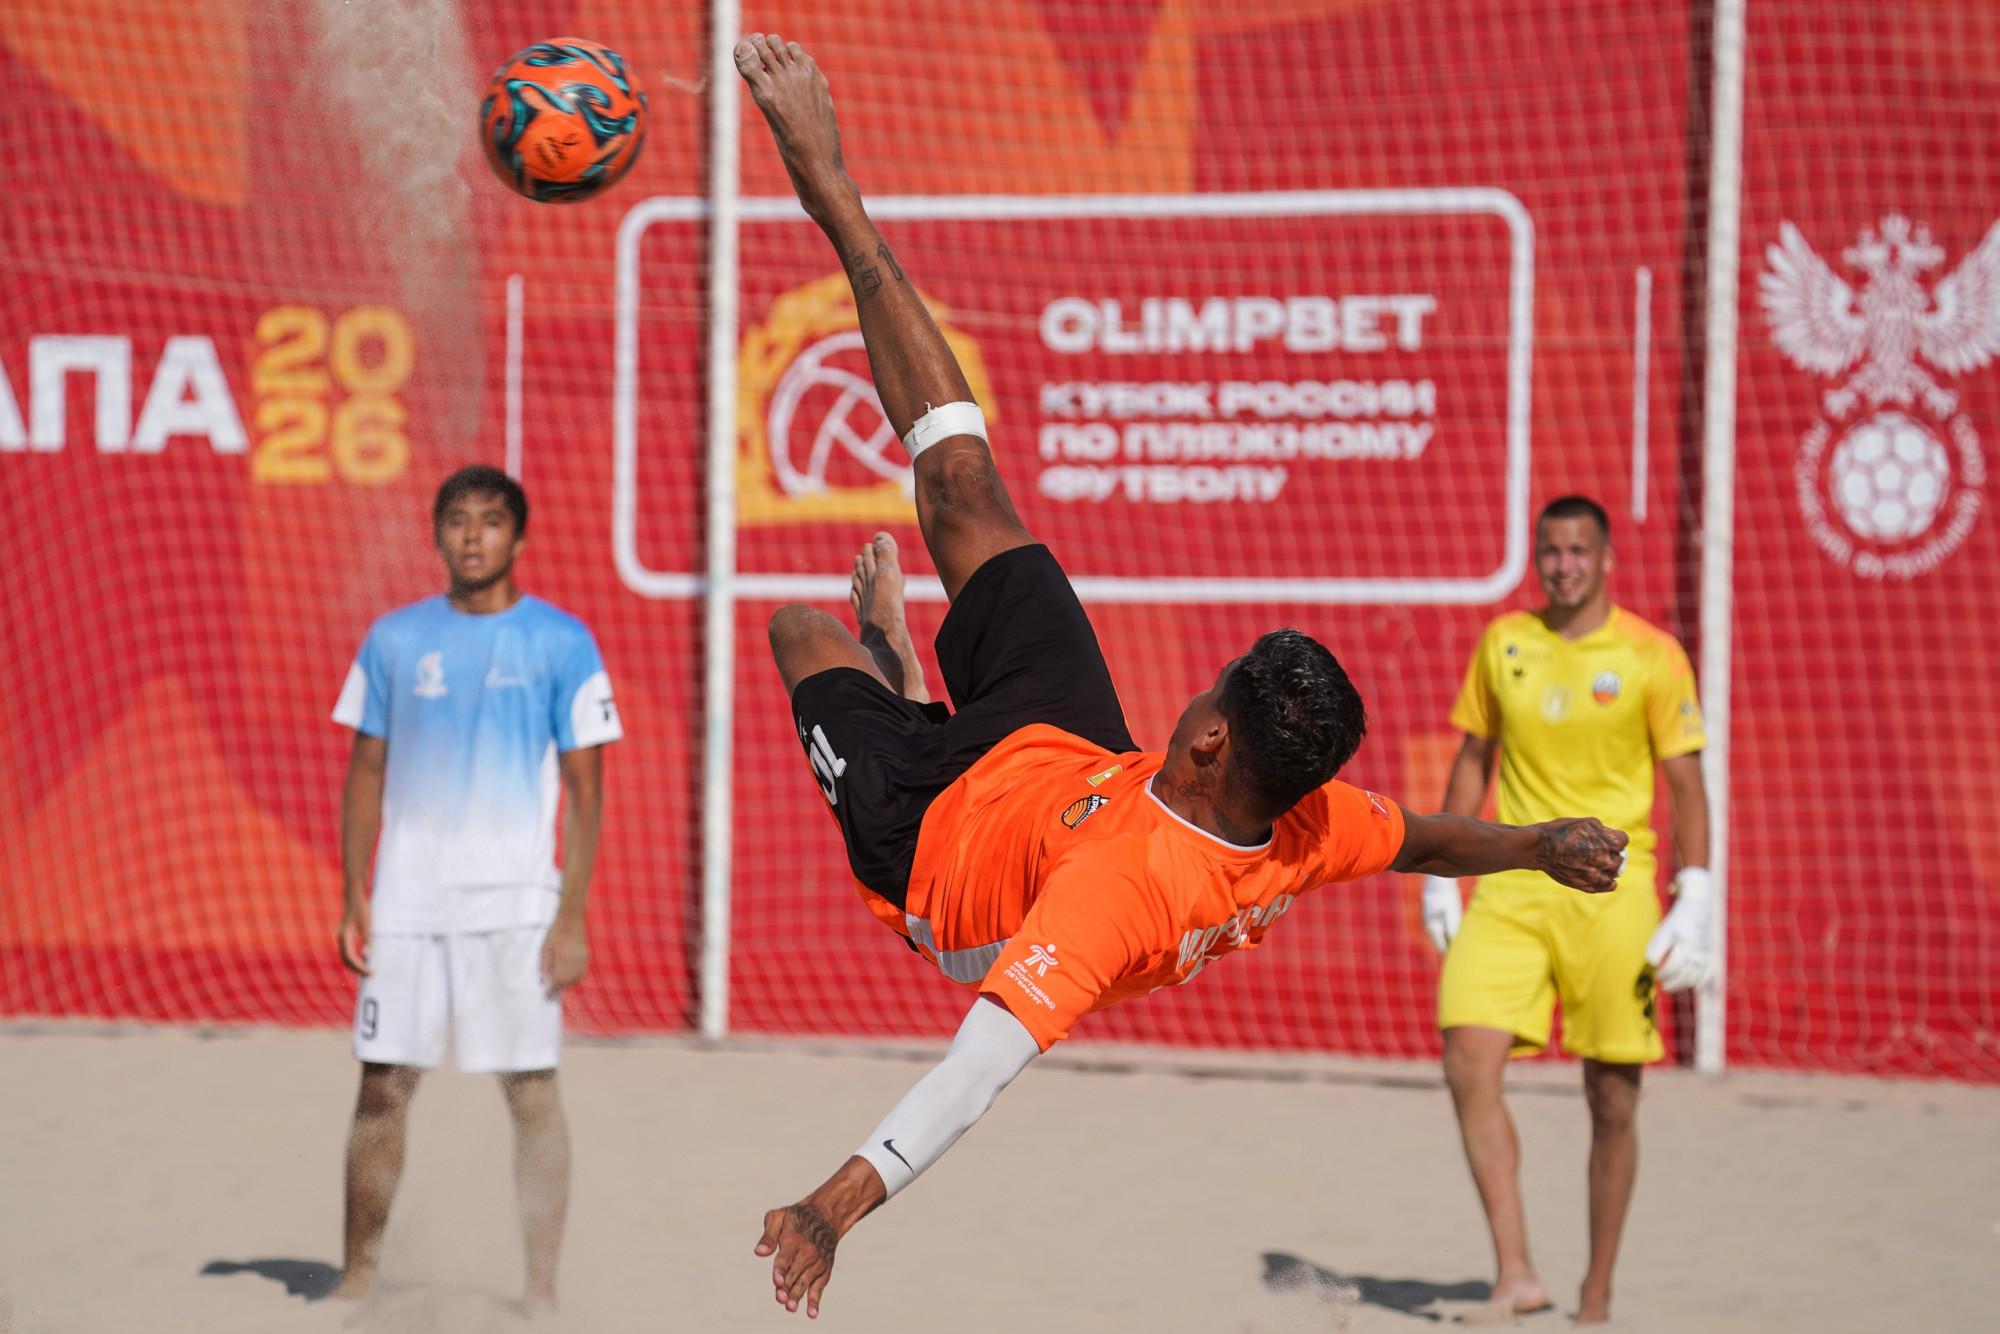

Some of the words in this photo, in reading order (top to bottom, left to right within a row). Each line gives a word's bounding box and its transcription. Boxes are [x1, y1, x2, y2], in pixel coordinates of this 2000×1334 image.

[1039, 294, 1437, 354] OLIMPBET
[252, 306, 414, 395] 20
[0, 335, 250, 454] ПА
[1040, 381, 1214, 418] КУБОК
[1218, 379, 1436, 418] РОССИИ
[252, 398, 411, 484] 26
[1039, 421, 1120, 461] ПО
[1123, 421, 1435, 461] ПЛЯЖНОМУ
[1038, 464, 1288, 502] ФУТБОЛУ
[1004, 969, 1042, 1005] ПЕТЕРБУРГ
[1009, 965, 1056, 1011] СПОРТИВНЫЙ
[361, 996, 379, 1042] 9
